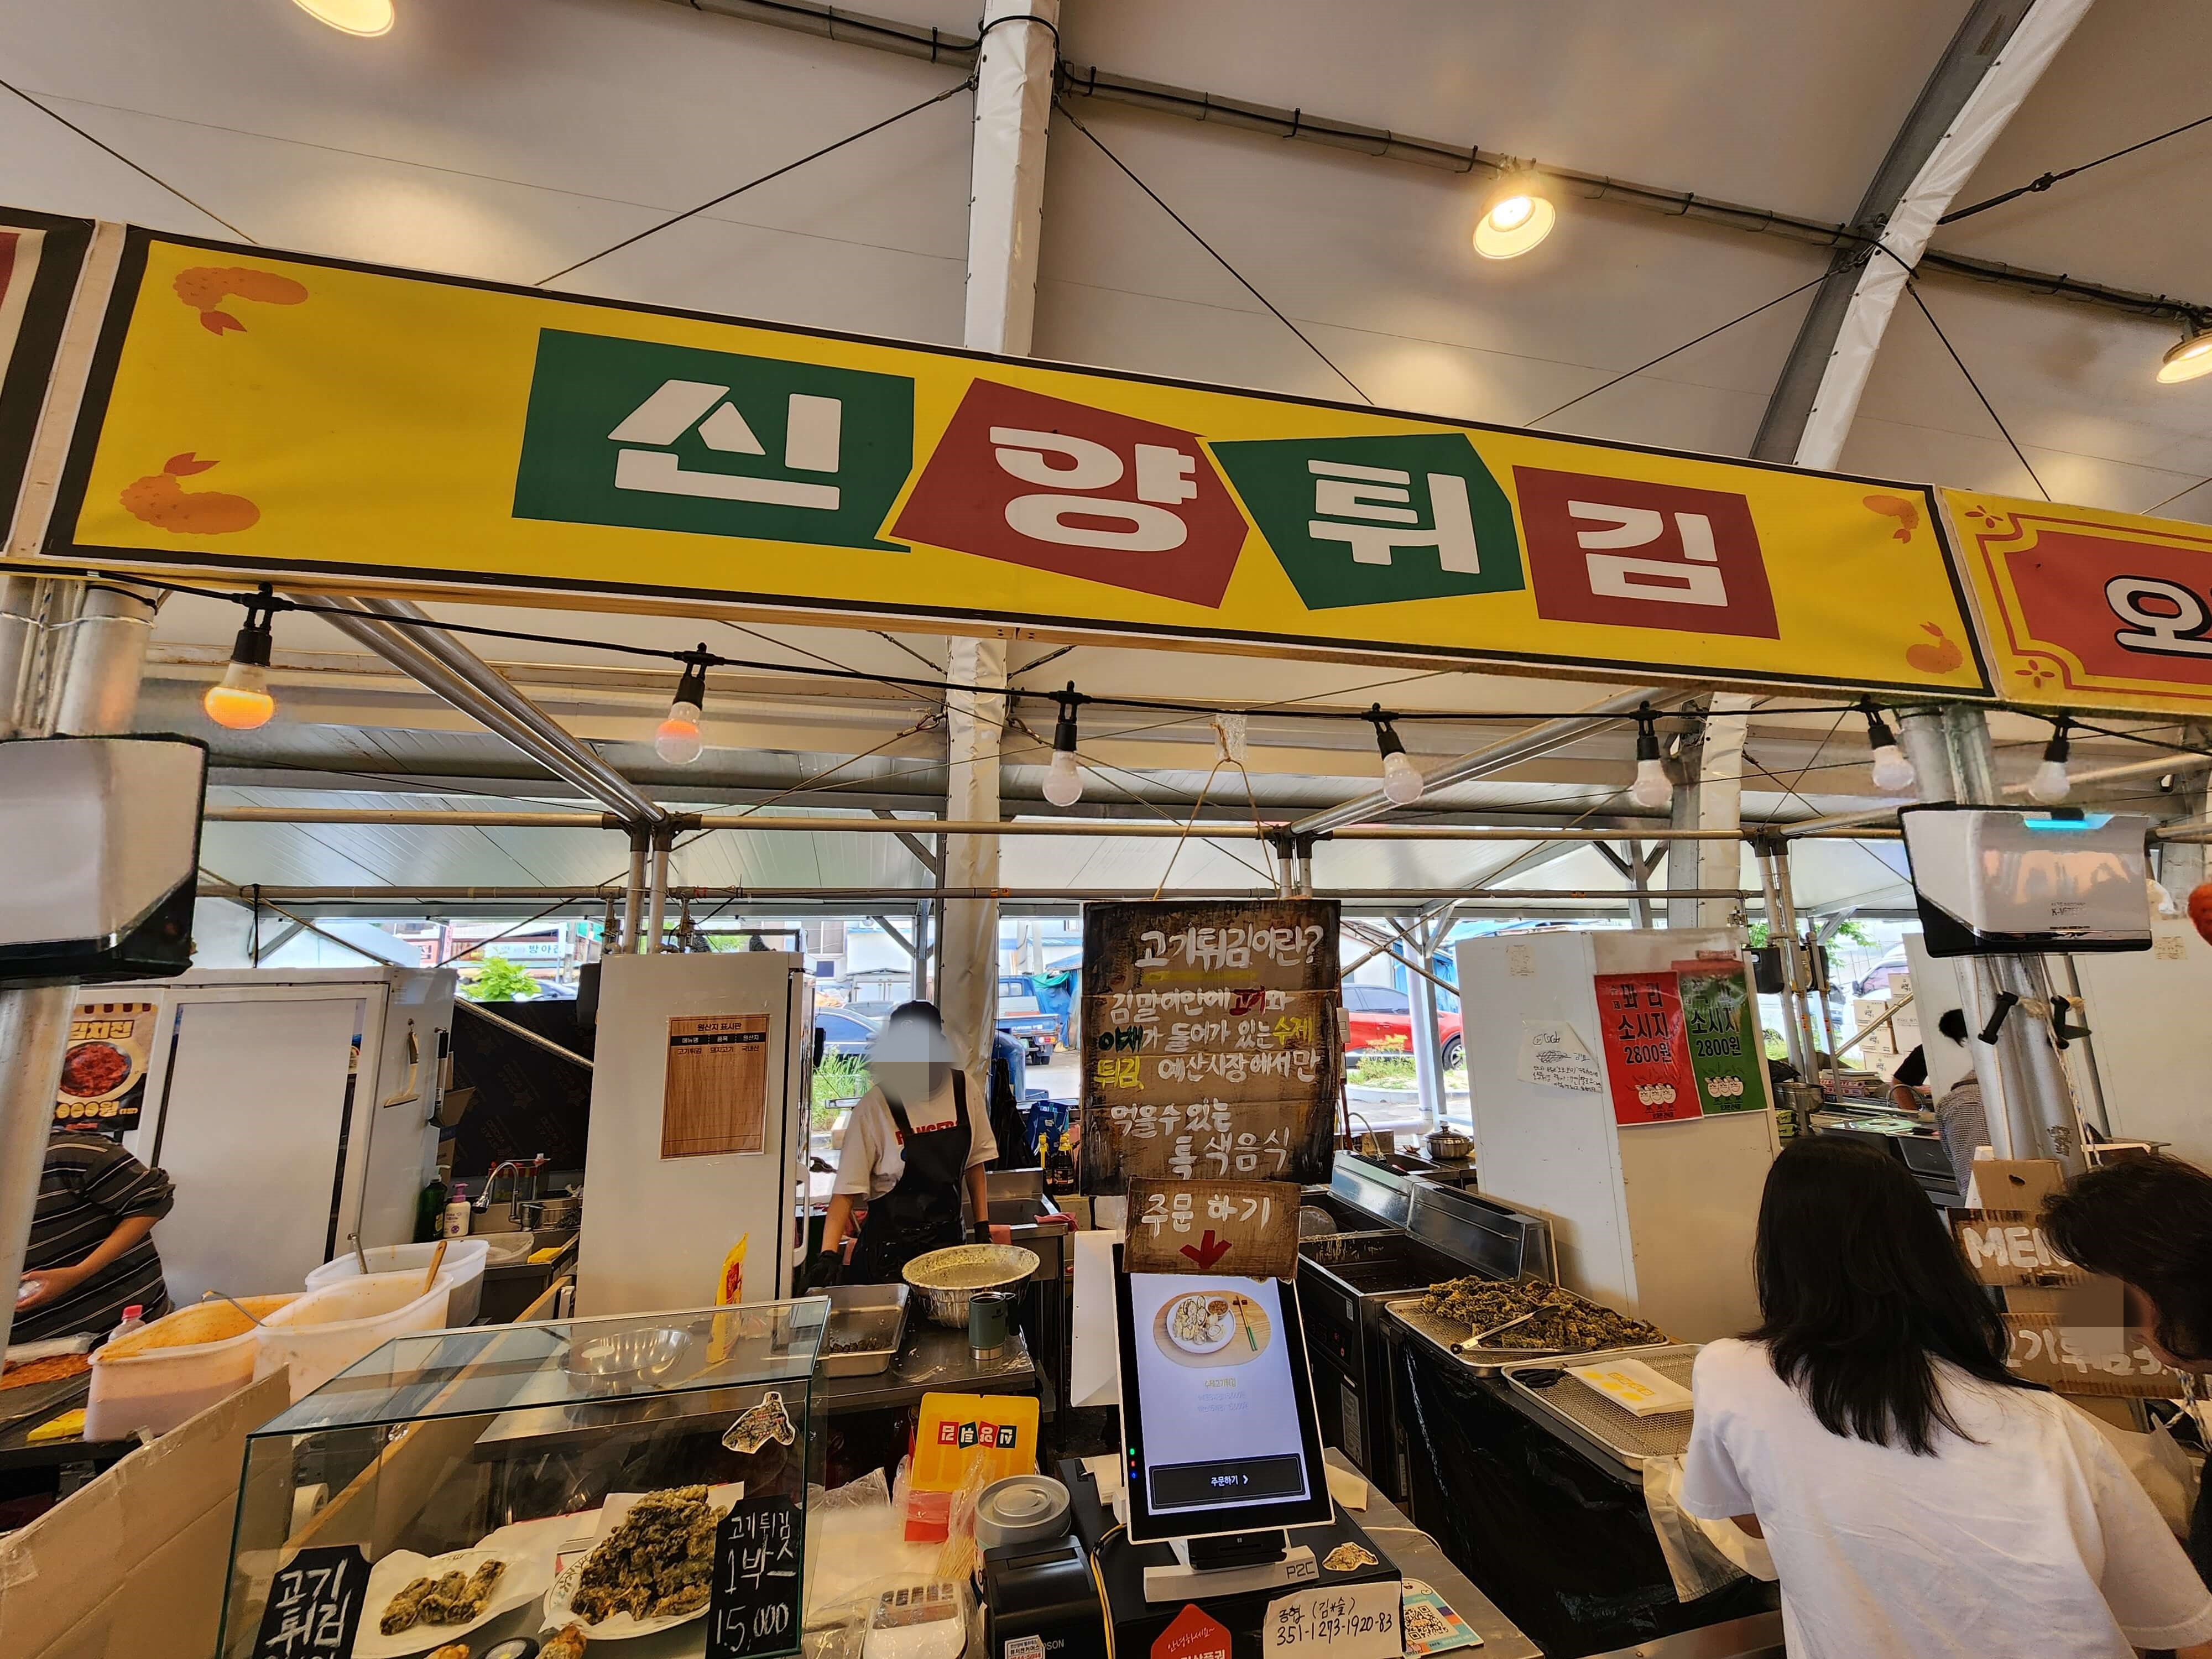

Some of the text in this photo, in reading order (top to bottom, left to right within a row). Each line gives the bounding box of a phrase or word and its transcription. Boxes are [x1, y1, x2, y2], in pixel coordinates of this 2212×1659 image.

[607, 379, 1729, 607] 신양튀김
[1135, 924, 1324, 972] 고기튀김이란?
[697, 1022, 742, 1032] 원산지 표시판
[1618, 1011, 1670, 1041] 소시지
[1691, 1006, 1740, 1035] 소시지
[1167, 1020, 1230, 1052] 들어가
[1238, 1019, 1275, 1048] 있는
[1272, 1016, 1313, 1045] 수제
[710, 1046, 734, 1054] 돼지고기
[1624, 1042, 1673, 1065] 2800원
[1695, 1036, 1743, 1058] 2800원
[56, 1100, 120, 1119] 000원
[941, 1425, 1013, 1444] 신양튀김
[1211, 1475, 1239, 1487] 주문하기
[728, 1510, 791, 1541] 고기튀김
[1286, 1561, 1316, 1579] P2C
[275, 1557, 348, 1609] 고기
[265, 1588, 353, 1658] 튀김
[1044, 1639, 1065, 1651] SON
